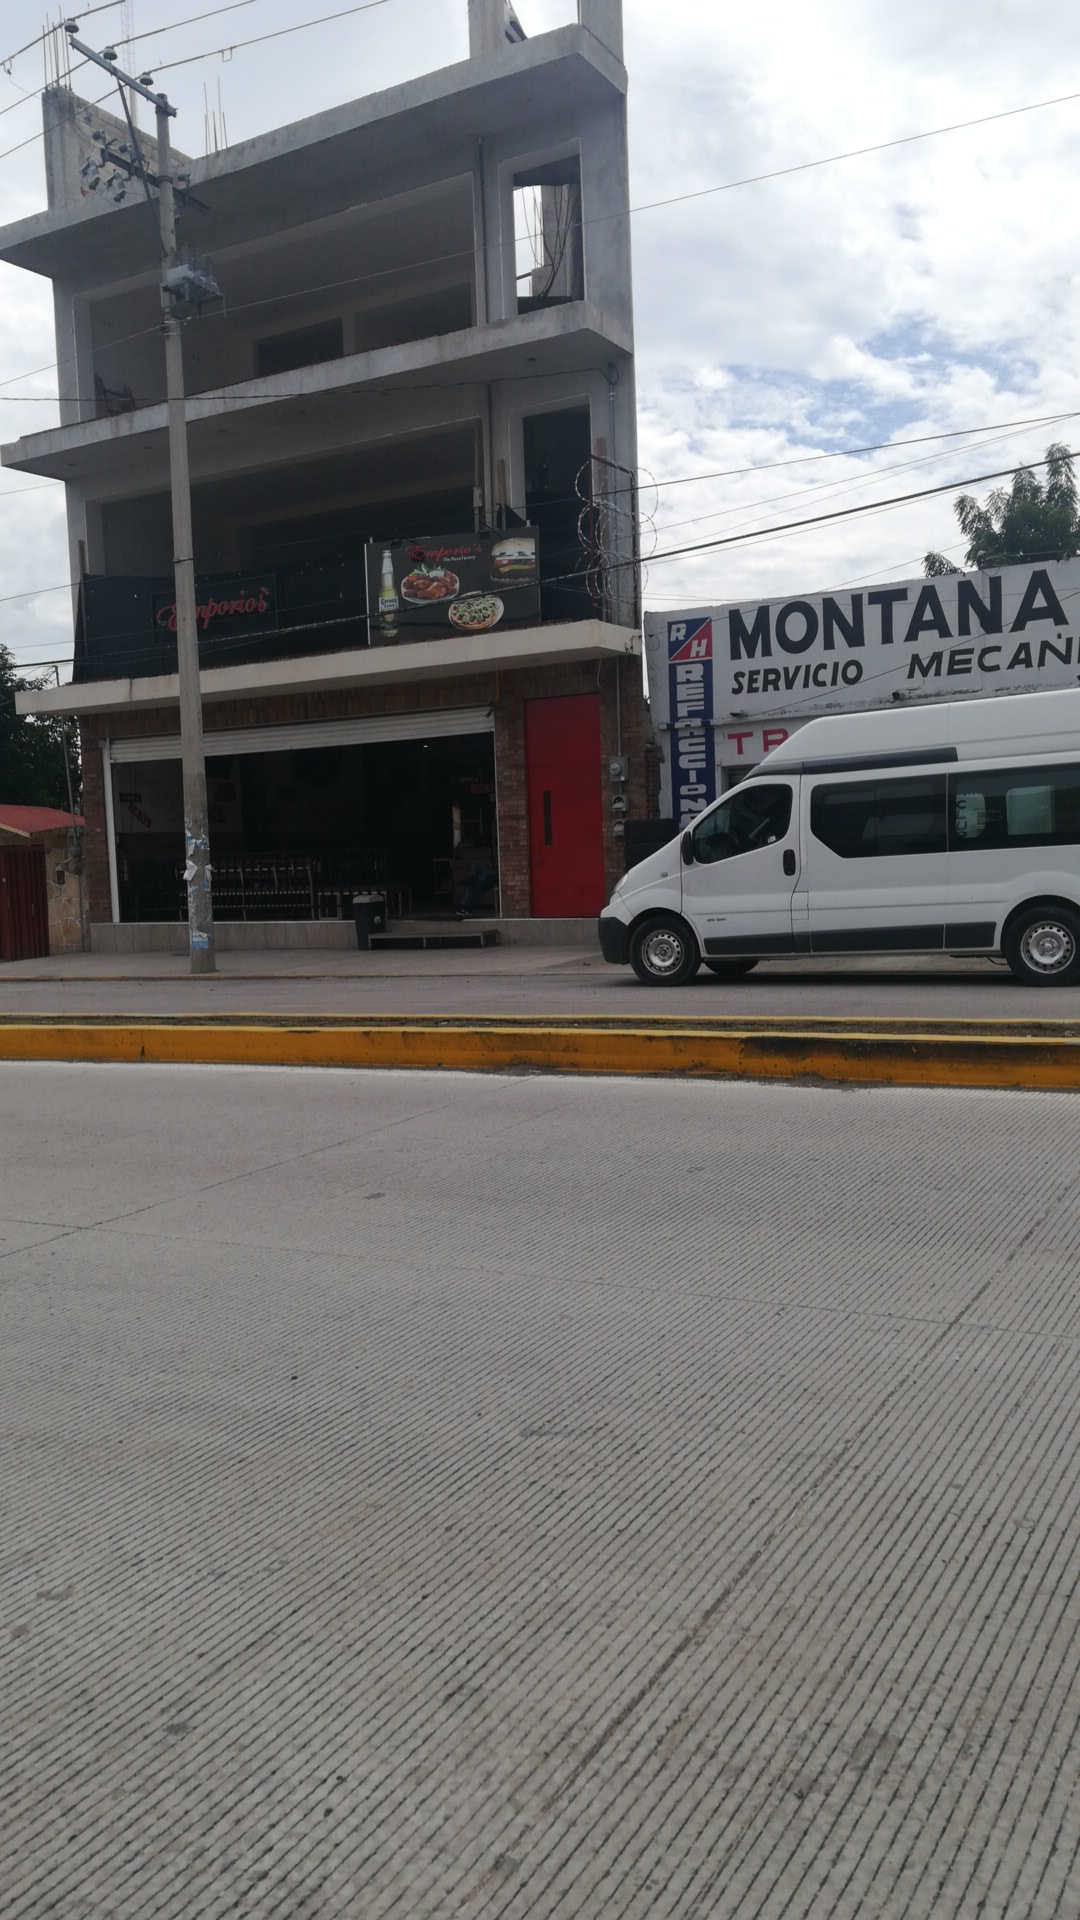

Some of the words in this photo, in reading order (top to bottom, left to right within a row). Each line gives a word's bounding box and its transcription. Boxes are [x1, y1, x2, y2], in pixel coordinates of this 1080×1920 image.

[728, 569, 1070, 660] MONTANA
[731, 659, 864, 695] SERVICIO
[907, 636, 1080, 680] MECAN
